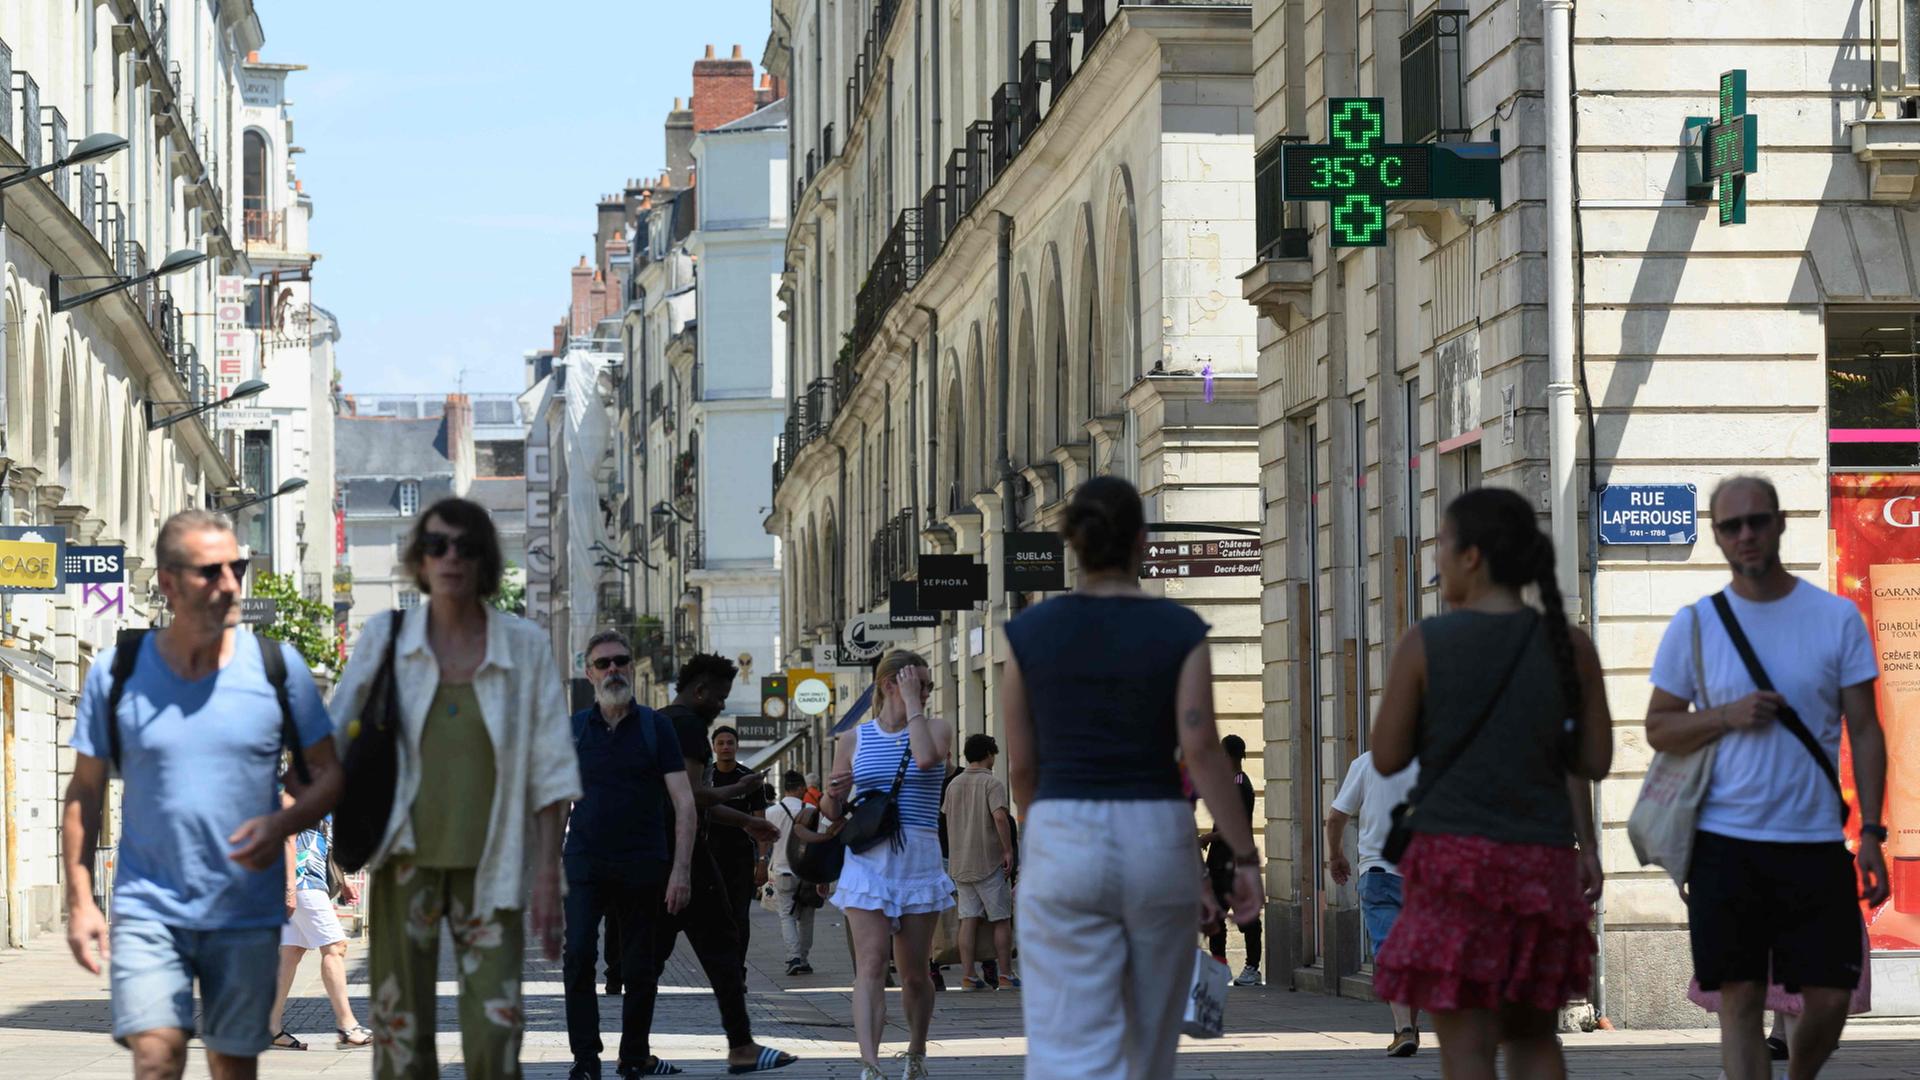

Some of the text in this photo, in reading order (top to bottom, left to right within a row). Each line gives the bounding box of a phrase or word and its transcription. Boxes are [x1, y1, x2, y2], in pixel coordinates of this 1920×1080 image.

[1630, 491, 1665, 506] RUE
[1602, 510, 1692, 525] LAPEROUSE
[1883, 496, 1920, 528] G
[1016, 552, 1053, 560] SUELAS
[0, 555, 49, 575] CAGE
[81, 556, 119, 573] TBS
[1882, 650, 1911, 660] CRÈME
[1884, 662, 1913, 671] BONNE
